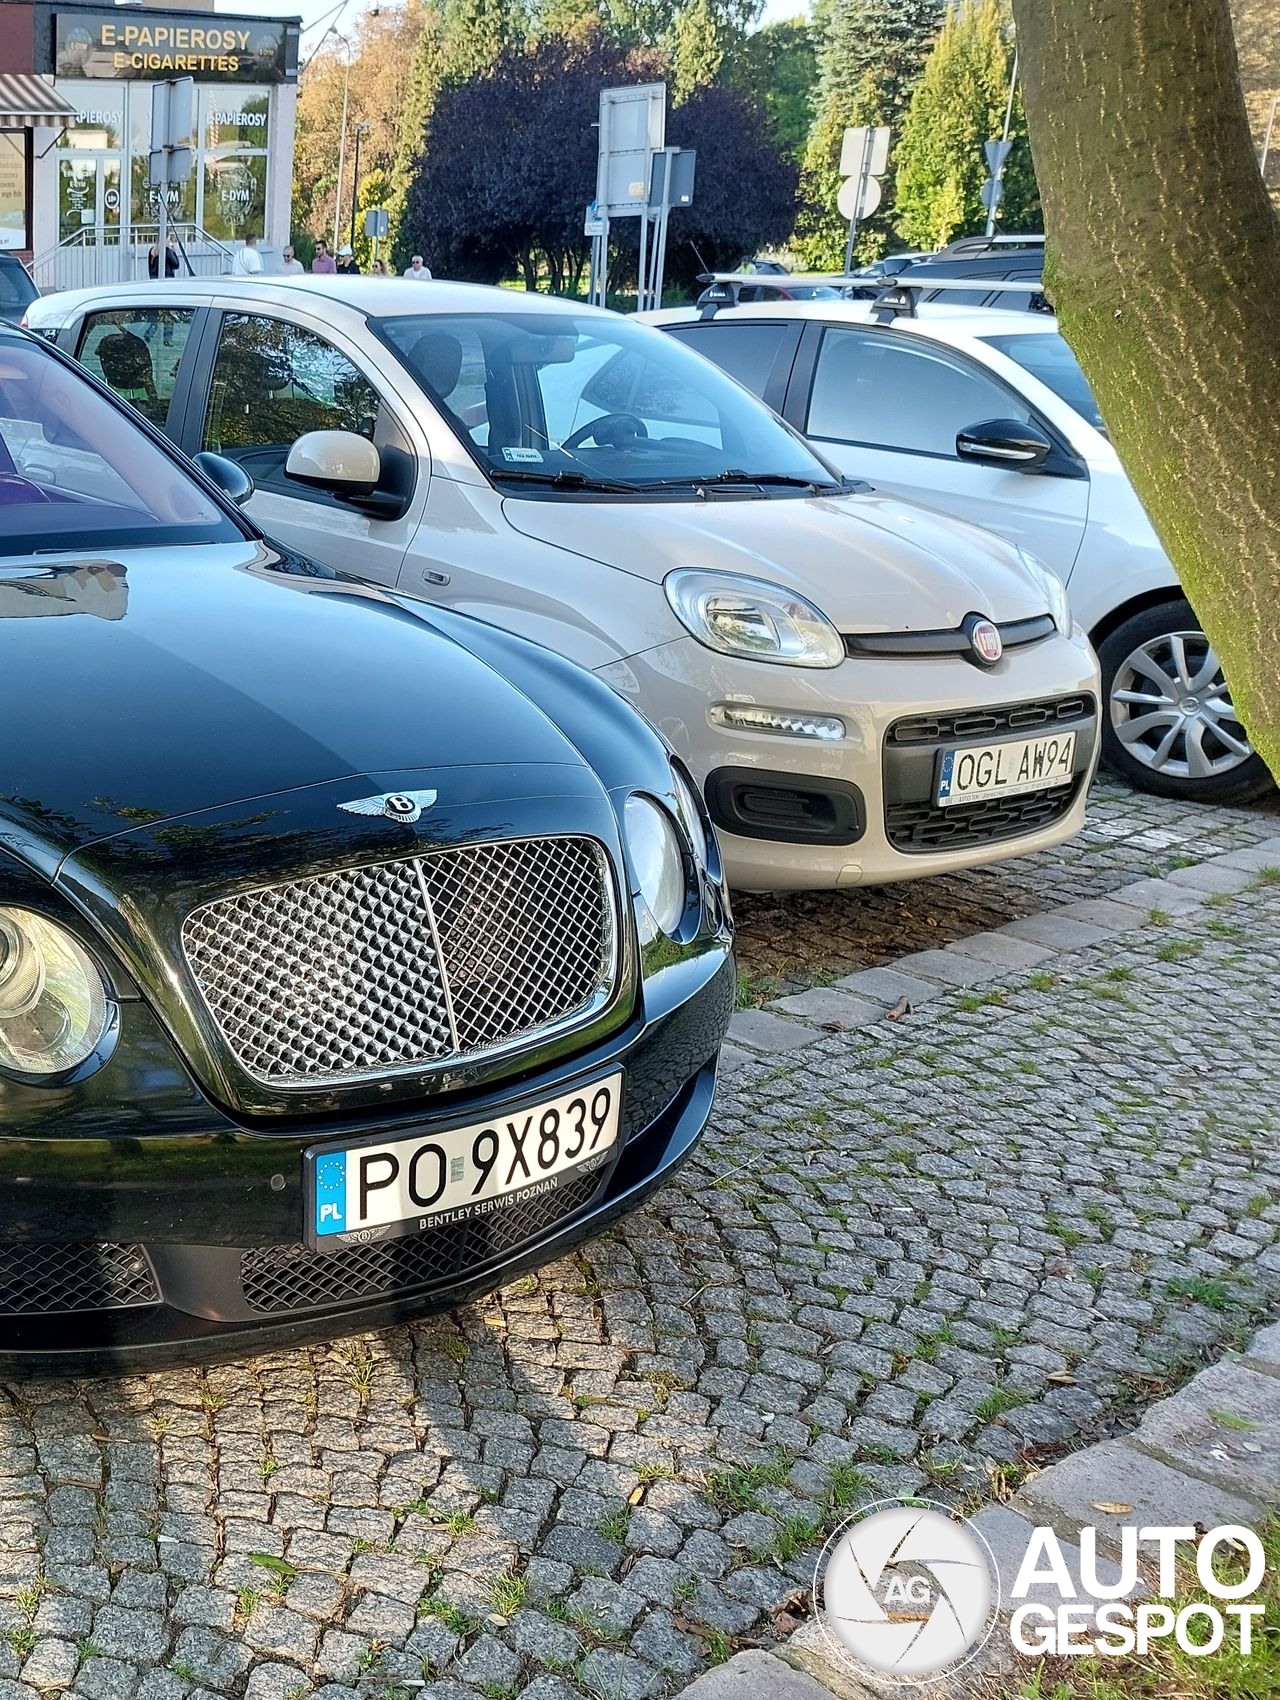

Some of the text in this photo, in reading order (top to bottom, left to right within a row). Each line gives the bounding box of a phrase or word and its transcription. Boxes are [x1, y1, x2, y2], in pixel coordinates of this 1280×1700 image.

[101, 24, 251, 50] E-PAPIEROSY
[113, 52, 239, 72] E-CIGARETTES
[221, 189, 250, 201] E-DYM
[940, 737, 1072, 791] PL OGL AW94
[320, 1087, 611, 1223] PL PO 9X839
[419, 1176, 558, 1230] BENTLEY SERWIS POZNAŃ
